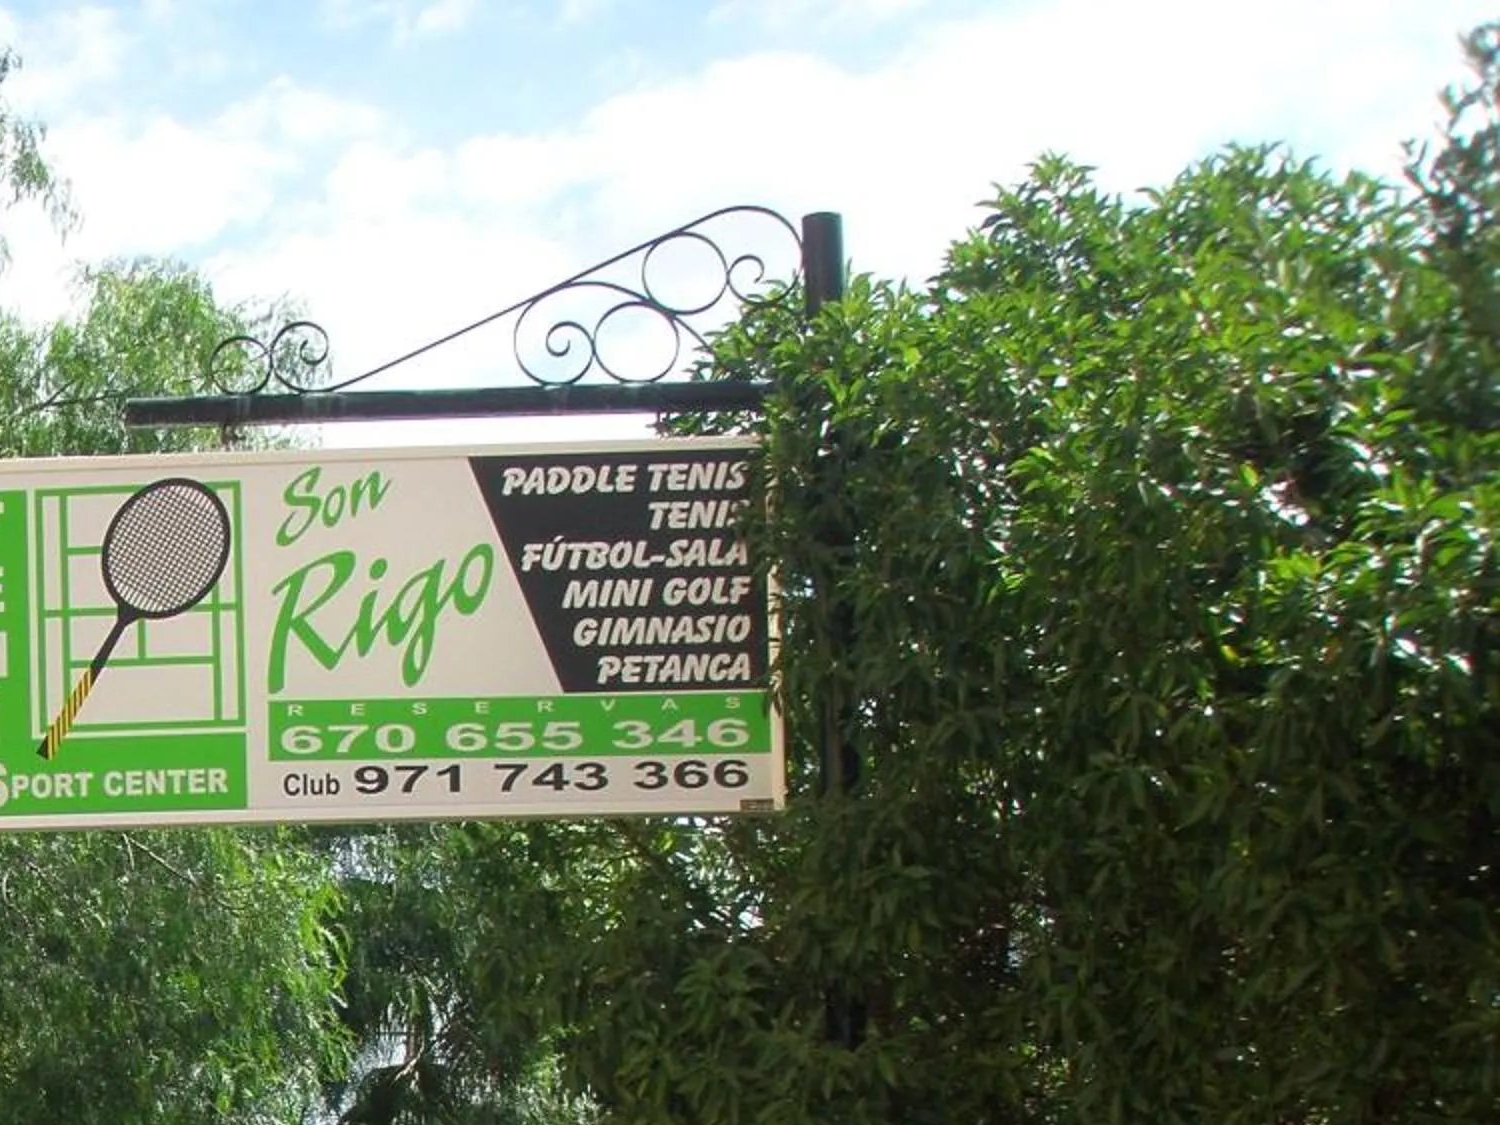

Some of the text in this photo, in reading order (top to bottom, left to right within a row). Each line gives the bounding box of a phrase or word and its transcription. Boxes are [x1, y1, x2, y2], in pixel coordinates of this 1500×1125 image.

[502, 460, 750, 496] PADDLE TENIS
[275, 465, 392, 547] Son
[520, 535, 748, 572] FÚTBOL-SALA
[561, 575, 752, 609] MINI GOLF
[267, 543, 495, 694] Rigo
[572, 613, 752, 648] GIMNASIO
[597, 654, 751, 685] PETANCA
[280, 718, 751, 755] 670 655 346
[103, 768, 228, 796] CENTER
[283, 760, 750, 797] Club 971 743 366
